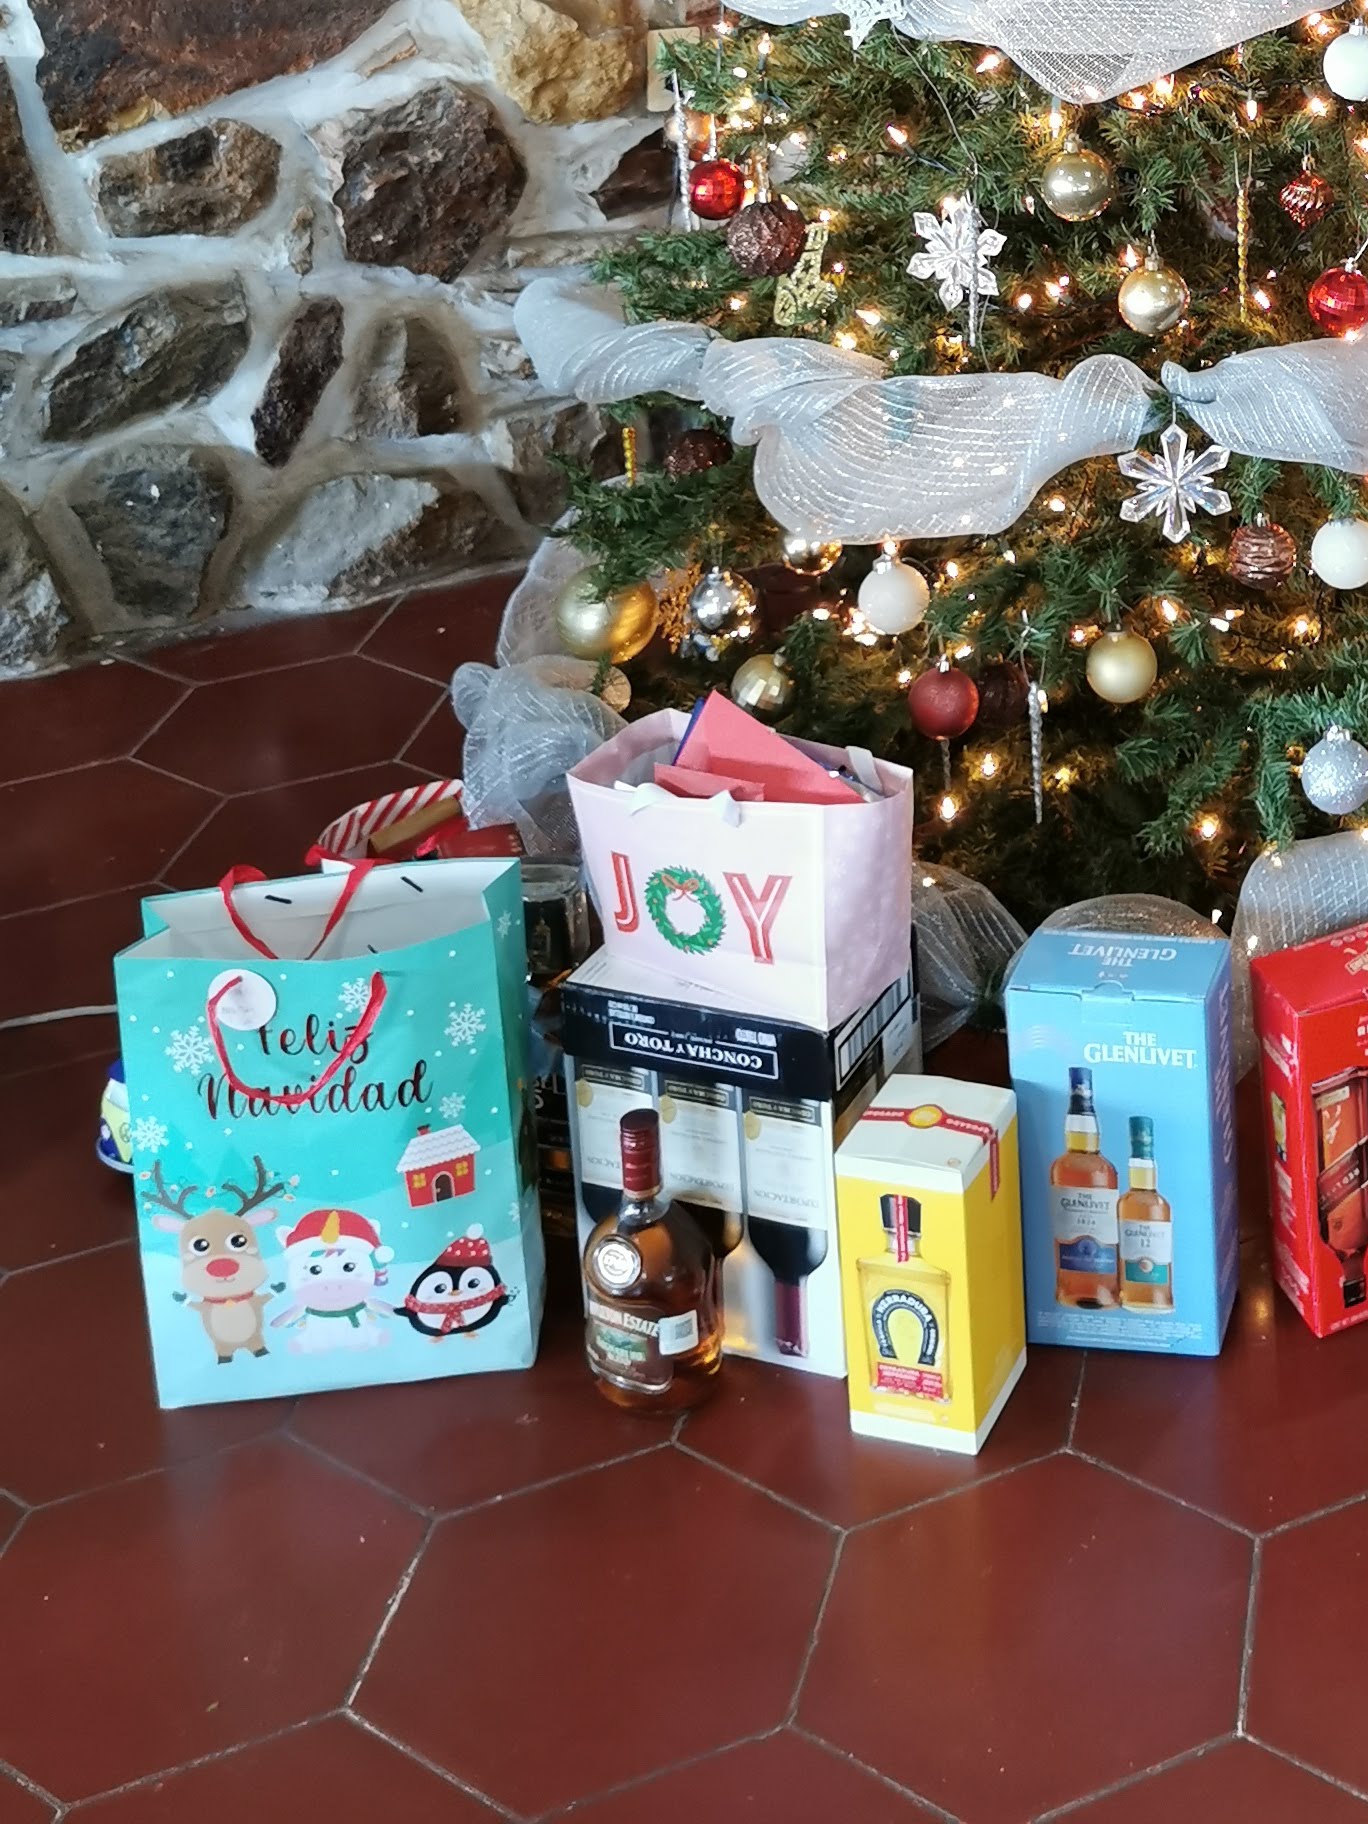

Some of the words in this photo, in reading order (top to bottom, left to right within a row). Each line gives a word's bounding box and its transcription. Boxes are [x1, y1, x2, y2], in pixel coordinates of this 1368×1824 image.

[611, 851, 793, 965] JOY
[1067, 943, 1177, 961] GLENLIVET
[1101, 956, 1133, 967] THE
[623, 1031, 675, 1053] TORO
[1122, 1031, 1157, 1047] THE
[686, 1042, 763, 1070] CONCHA
[1083, 1042, 1197, 1069] GLENLIVET
[197, 1058, 434, 1120] Navidad
[876, 1294, 933, 1324] HERRADURA
